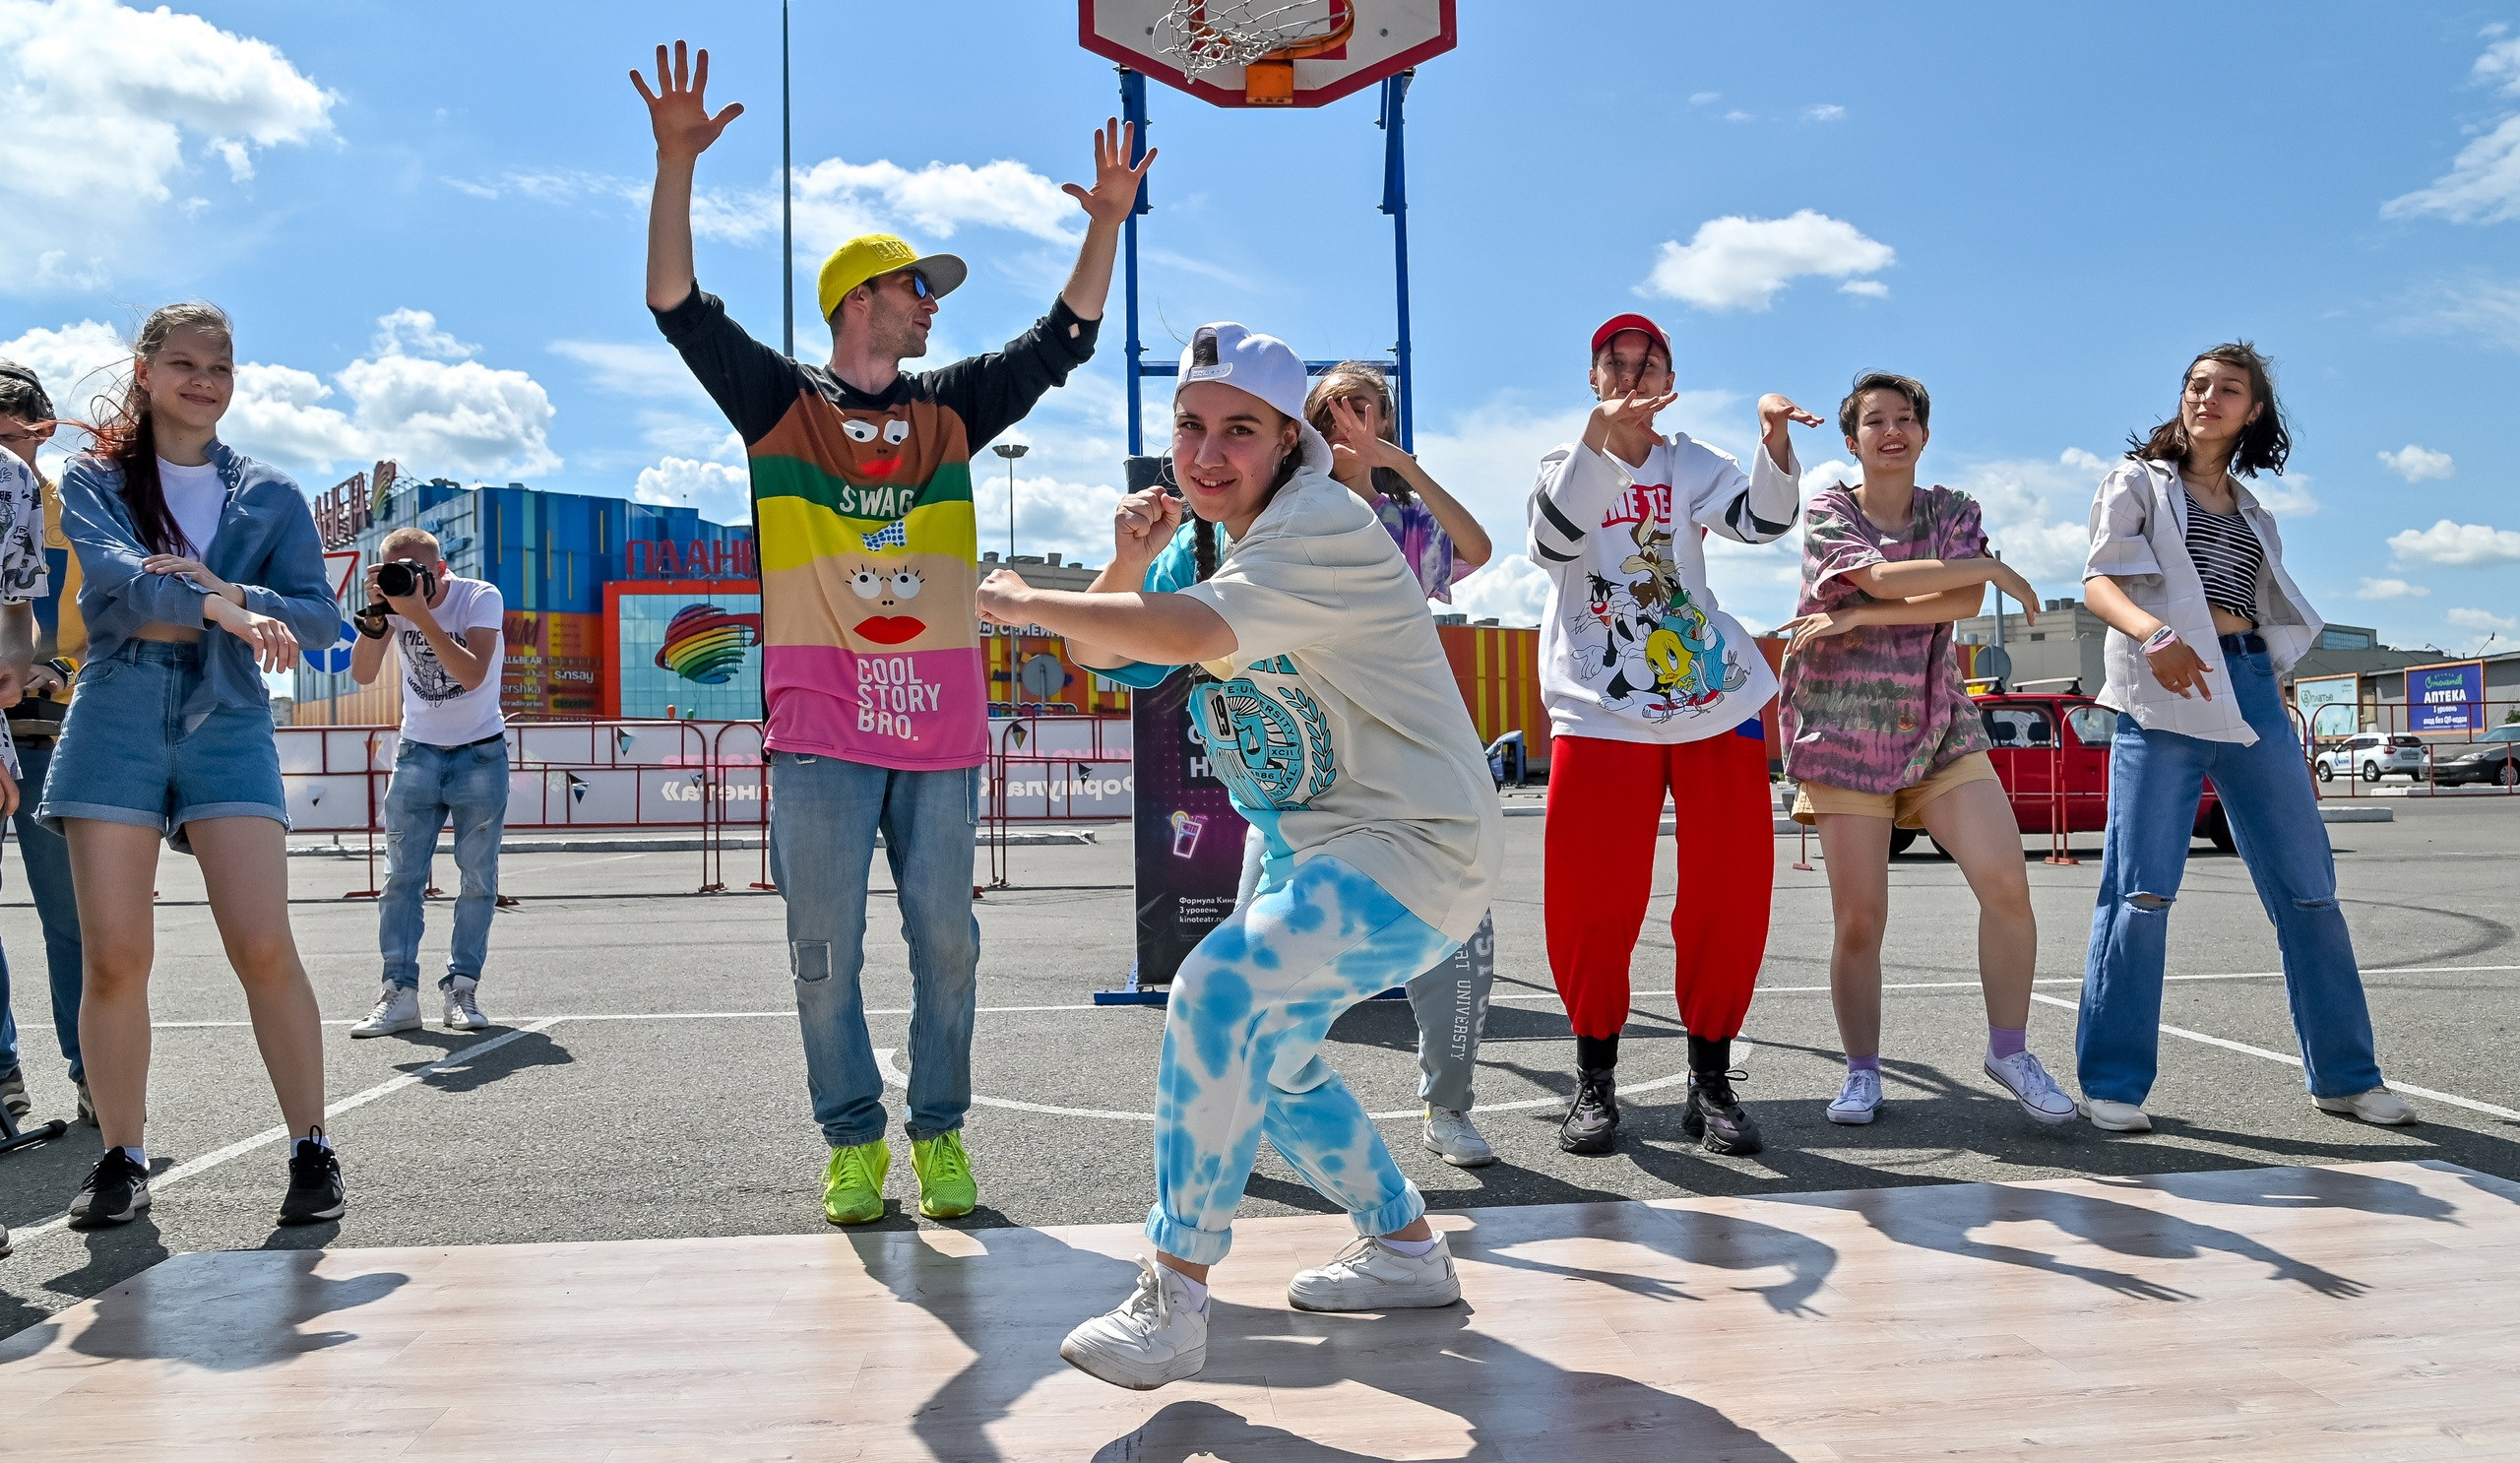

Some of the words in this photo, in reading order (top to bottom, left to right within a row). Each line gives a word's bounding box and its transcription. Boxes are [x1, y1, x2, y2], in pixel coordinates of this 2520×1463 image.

[839, 484, 914, 518] SWAG
[1602, 488, 1641, 524] NE
[857, 657, 923, 685] COOL
[857, 683, 942, 713] STORY
[2424, 688, 2467, 705] АПТЕКА
[857, 707, 918, 741] BRO.
[1179, 897, 1216, 906] Формула
